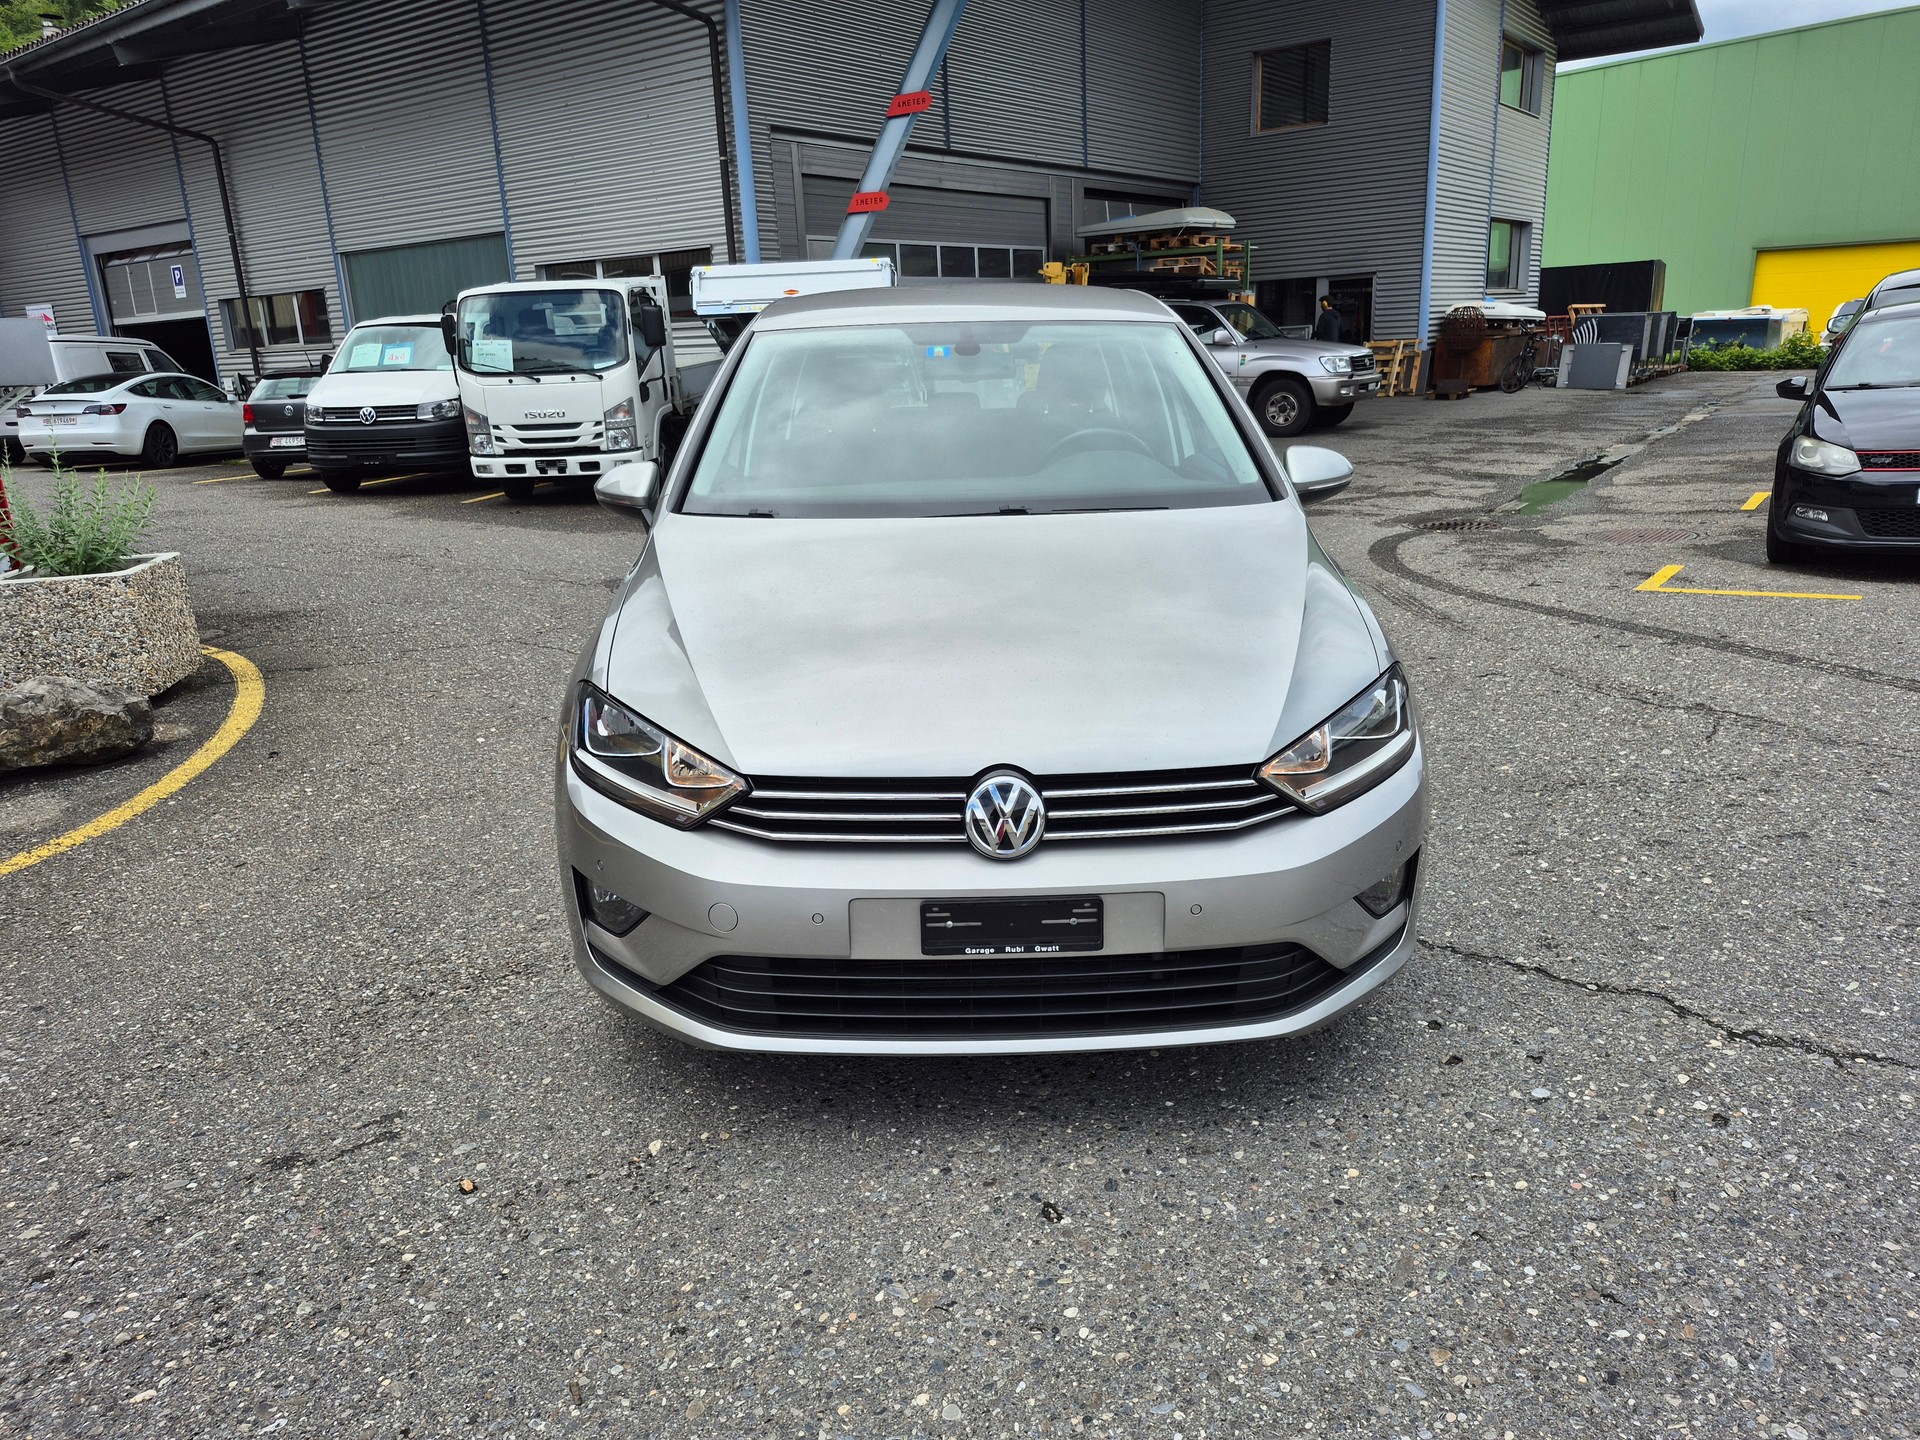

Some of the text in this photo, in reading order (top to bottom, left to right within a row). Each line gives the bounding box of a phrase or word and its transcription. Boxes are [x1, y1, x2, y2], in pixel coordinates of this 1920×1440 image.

[174, 270, 181, 283] P
[388, 352, 407, 361] 4x4
[524, 409, 566, 419] ISUZU
[965, 947, 995, 955] Garage
